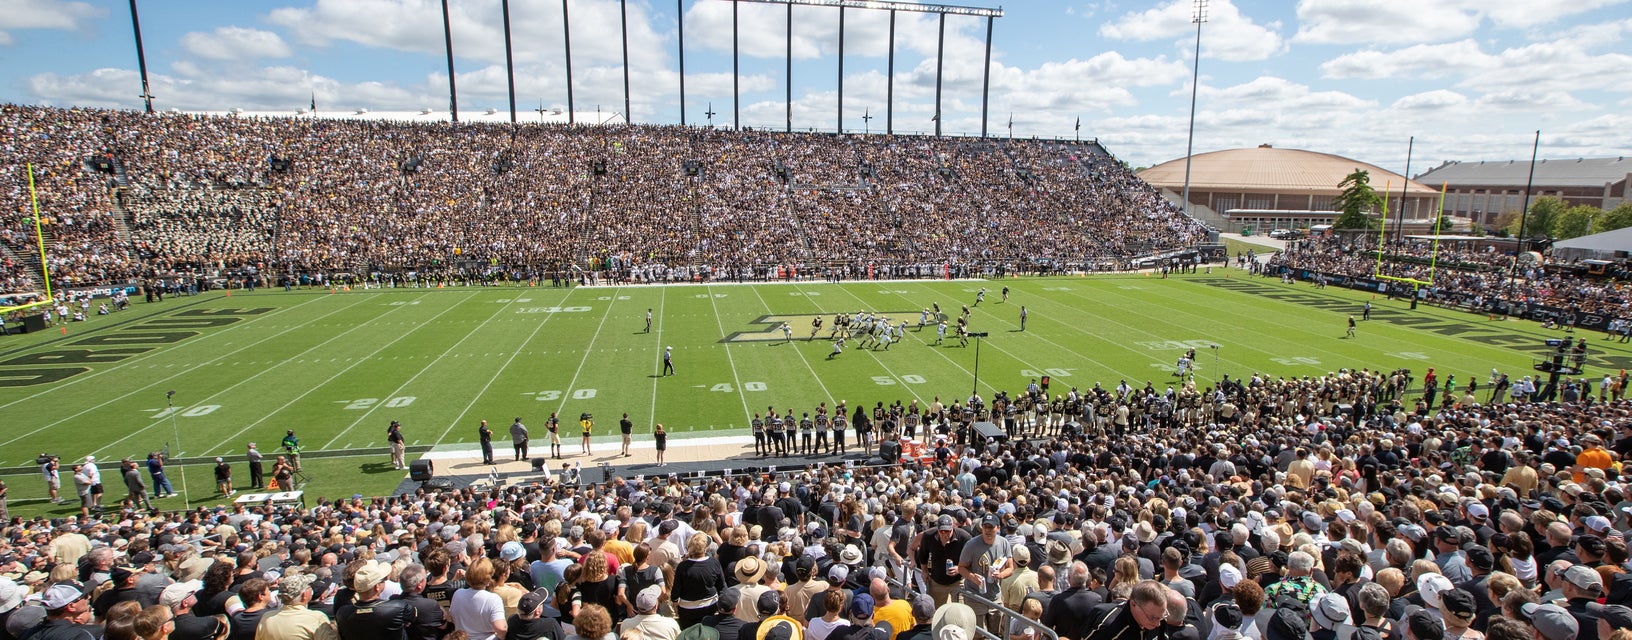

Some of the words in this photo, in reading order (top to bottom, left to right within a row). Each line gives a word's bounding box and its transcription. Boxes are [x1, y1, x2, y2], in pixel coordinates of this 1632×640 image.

[67, 286, 136, 297] Booing.cm
[870, 374, 927, 386] 50
[710, 381, 768, 393] 40
[535, 388, 598, 401] 30
[343, 396, 417, 410] 20
[149, 404, 222, 419] 10
[427, 591, 446, 600] BREES
